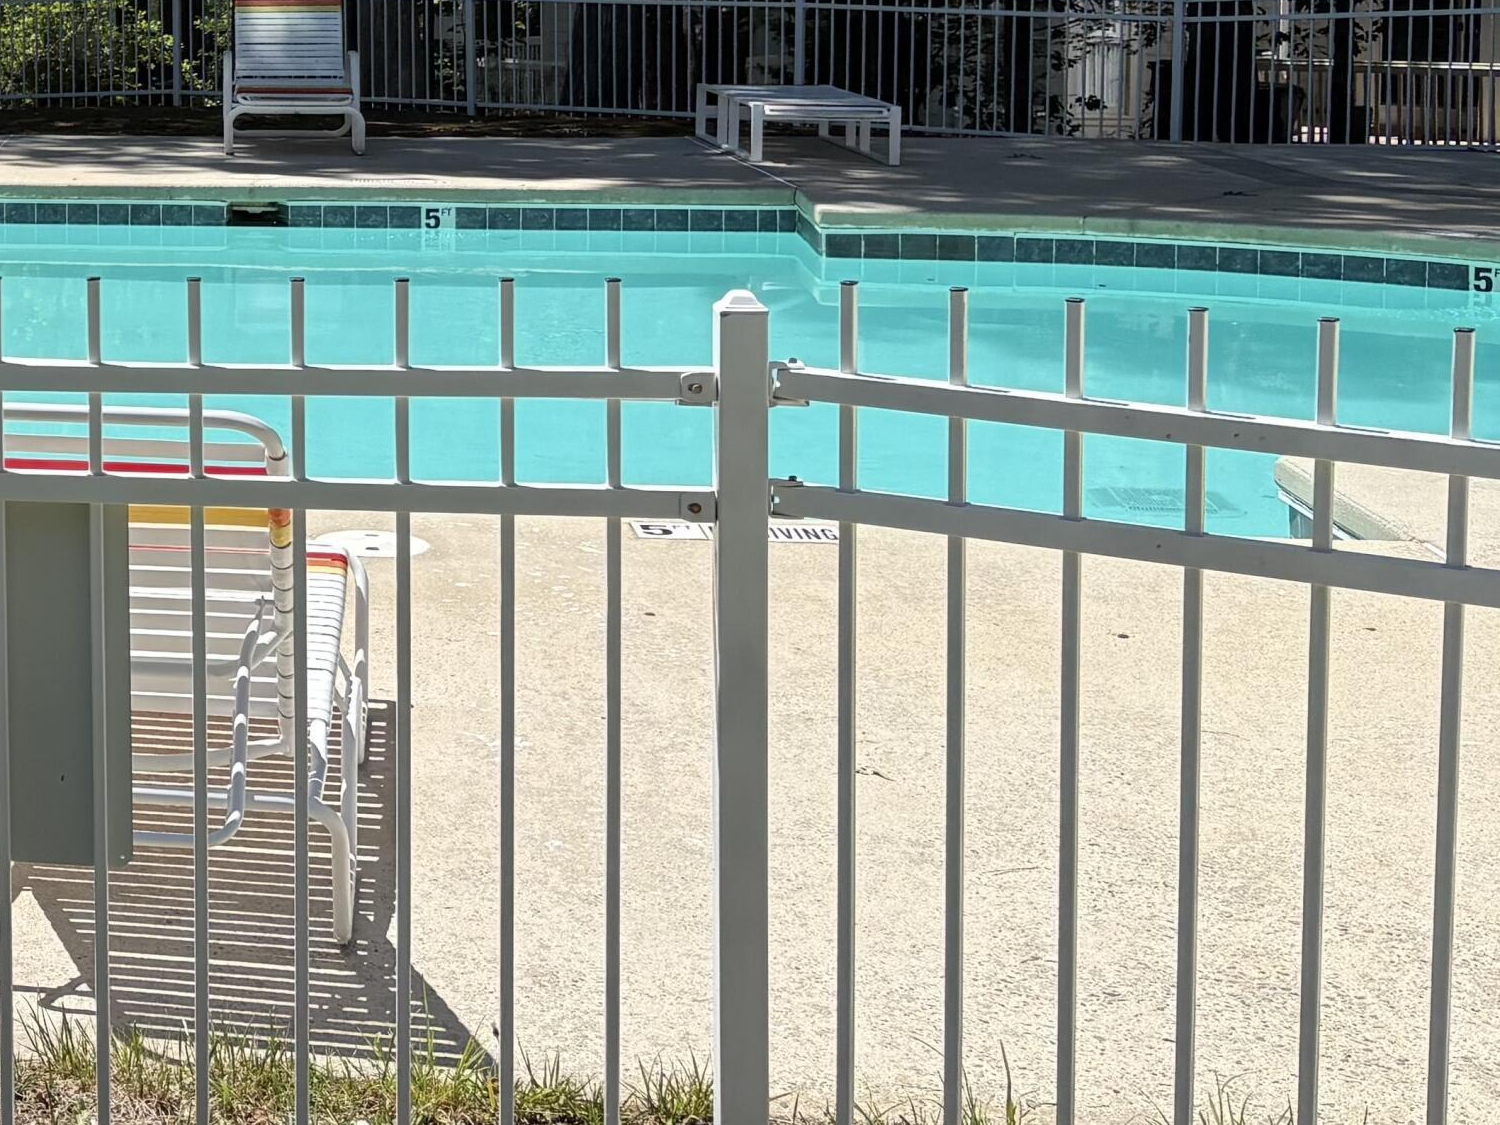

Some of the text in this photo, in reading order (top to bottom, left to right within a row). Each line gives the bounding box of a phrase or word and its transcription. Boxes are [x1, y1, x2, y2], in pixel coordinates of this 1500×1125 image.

[425, 208, 451, 228] 5 FT
[1474, 267, 1493, 292] 5
[640, 525, 672, 535] 5
[768, 527, 839, 540] IVING
